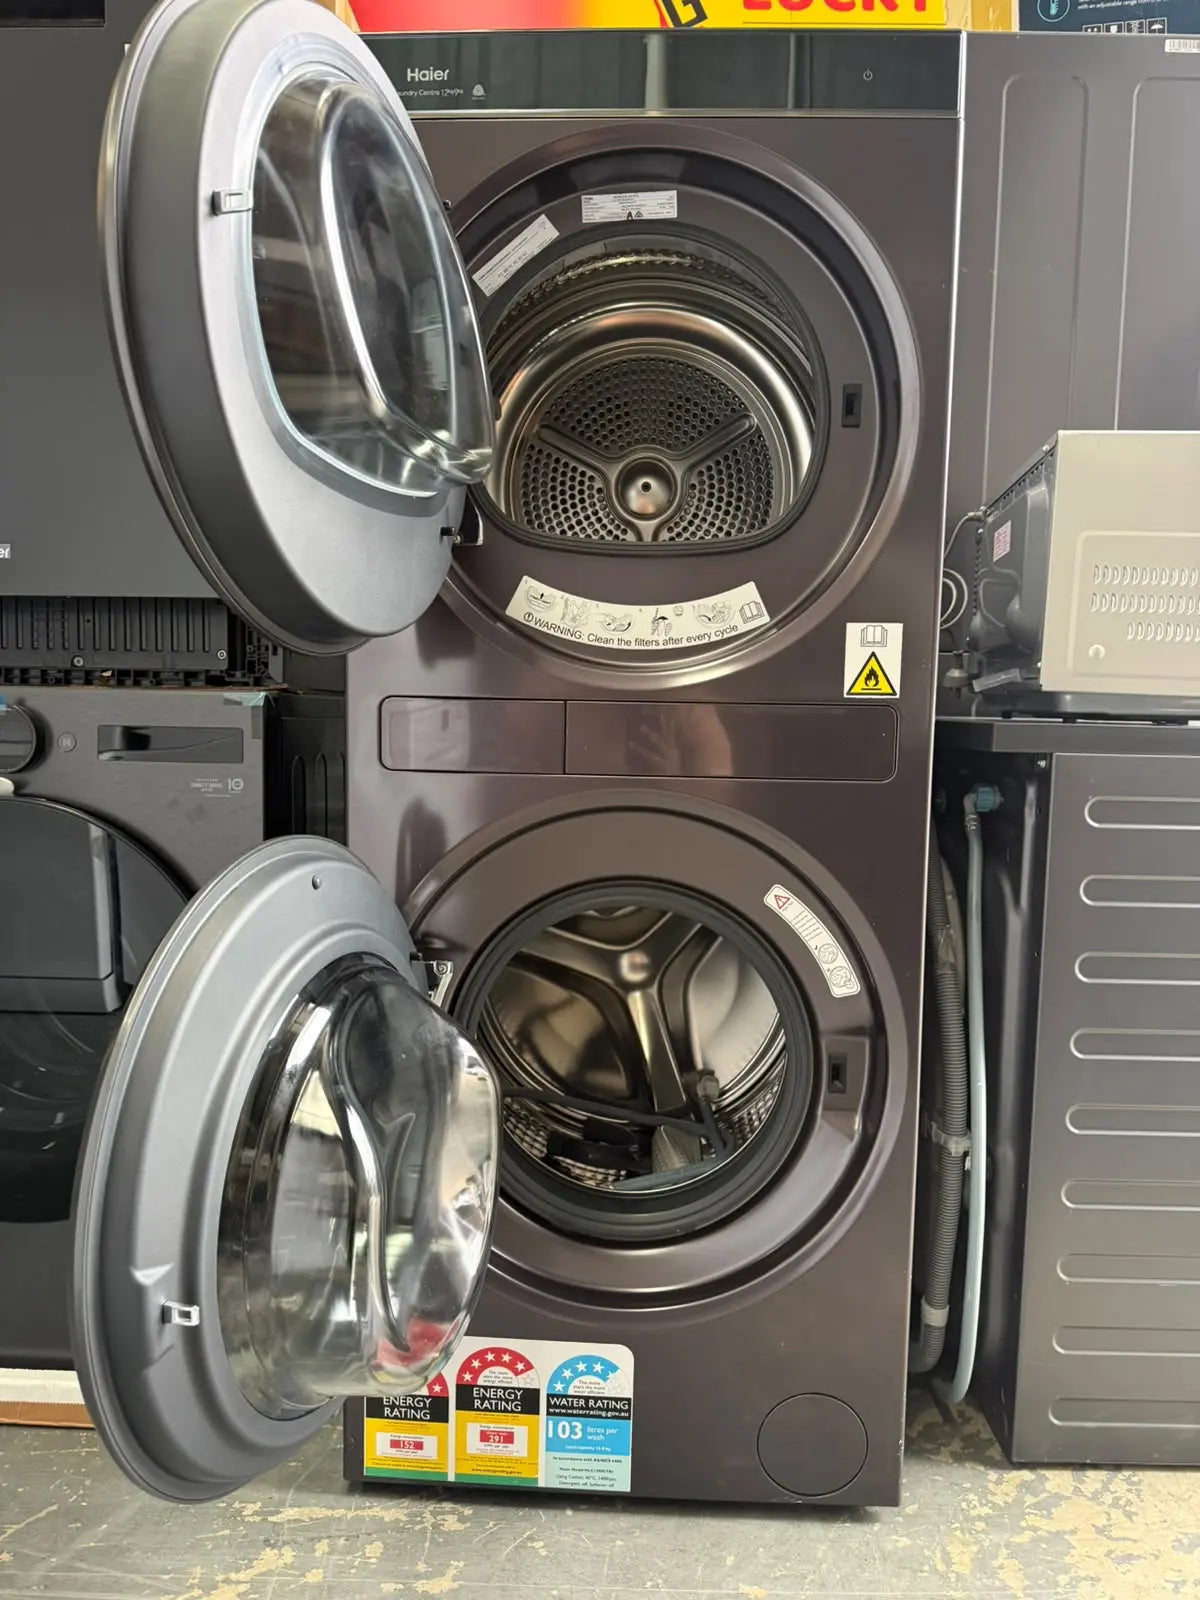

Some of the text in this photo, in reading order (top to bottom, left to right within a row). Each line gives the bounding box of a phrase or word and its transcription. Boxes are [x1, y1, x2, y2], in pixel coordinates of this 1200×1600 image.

[406, 66, 450, 82] Haier
[418, 88, 440, 96] Centre
[534, 617, 738, 648] WARNING: Clean the filters after every cycle
[473, 1387, 523, 1400] ENERGY
[383, 1397, 432, 1408] ENERGY
[474, 1399, 522, 1412] RATING
[549, 1397, 629, 1410] WATER RATING
[384, 1407, 430, 1420] RATING
[549, 1408, 629, 1417] www.waterrating.gov.au
[547, 1420, 582, 1440] 103
[606, 1428, 618, 1436] per
[400, 1440, 416, 1449] 152
[488, 1434, 504, 1444] 291
